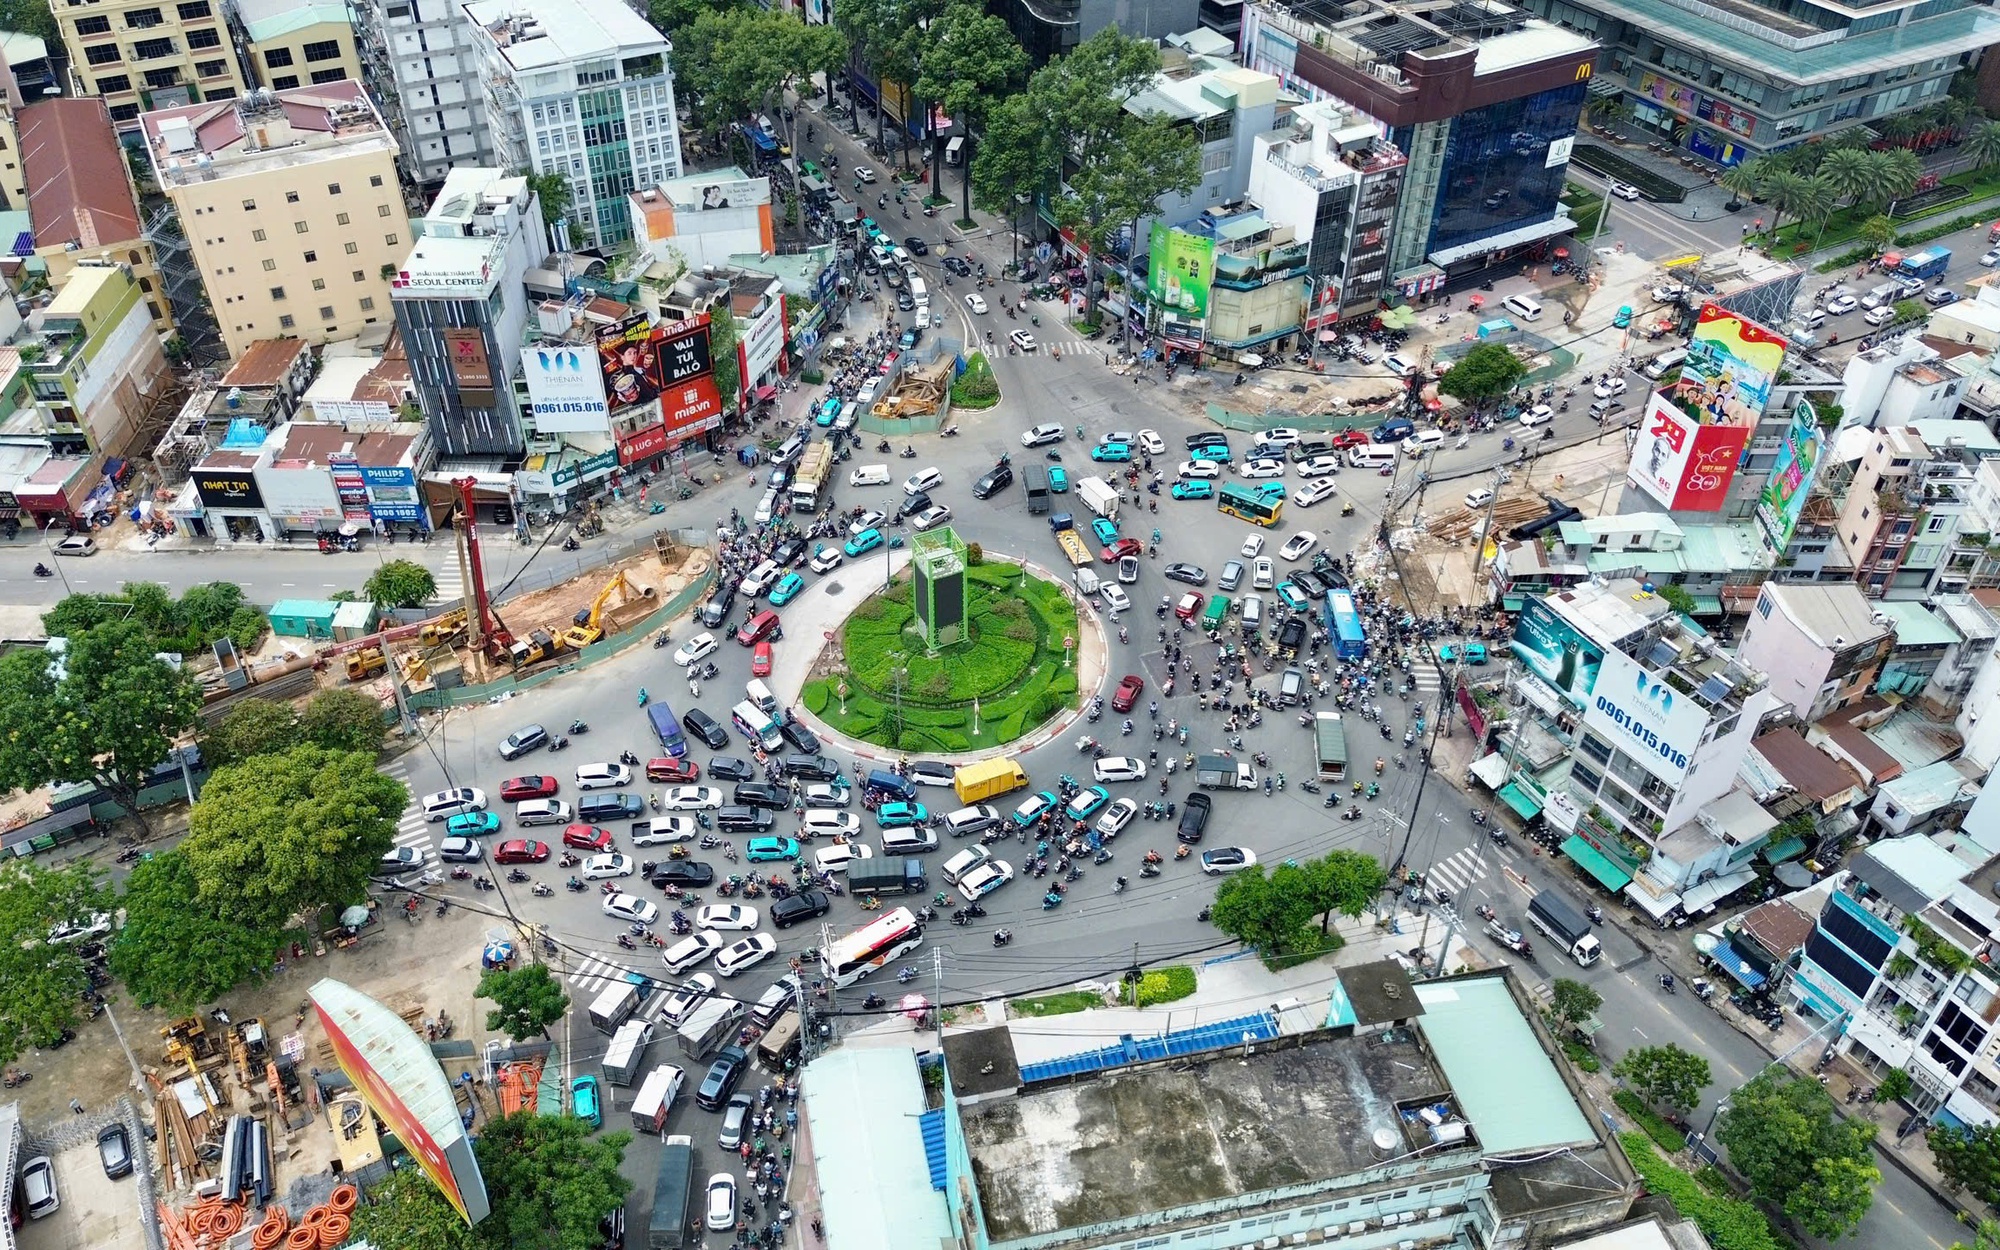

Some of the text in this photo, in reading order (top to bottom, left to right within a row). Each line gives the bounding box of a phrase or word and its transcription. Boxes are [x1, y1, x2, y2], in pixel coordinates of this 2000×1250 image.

[445, 278, 485, 286] CENTER
[1262, 268, 1291, 285] KATINAT
[756, 314, 775, 337] HONDA
[673, 337, 694, 351] VALI
[676, 350, 694, 364] TÚI
[673, 360, 701, 379] BALÔ
[534, 402, 605, 414] 0961.015.016
[674, 400, 711, 420] mia.vn
[367, 470, 405, 478] PHILIPS
[1596, 696, 1687, 770] 0961.015.016
[1918, 1070, 1944, 1095] VENUS
